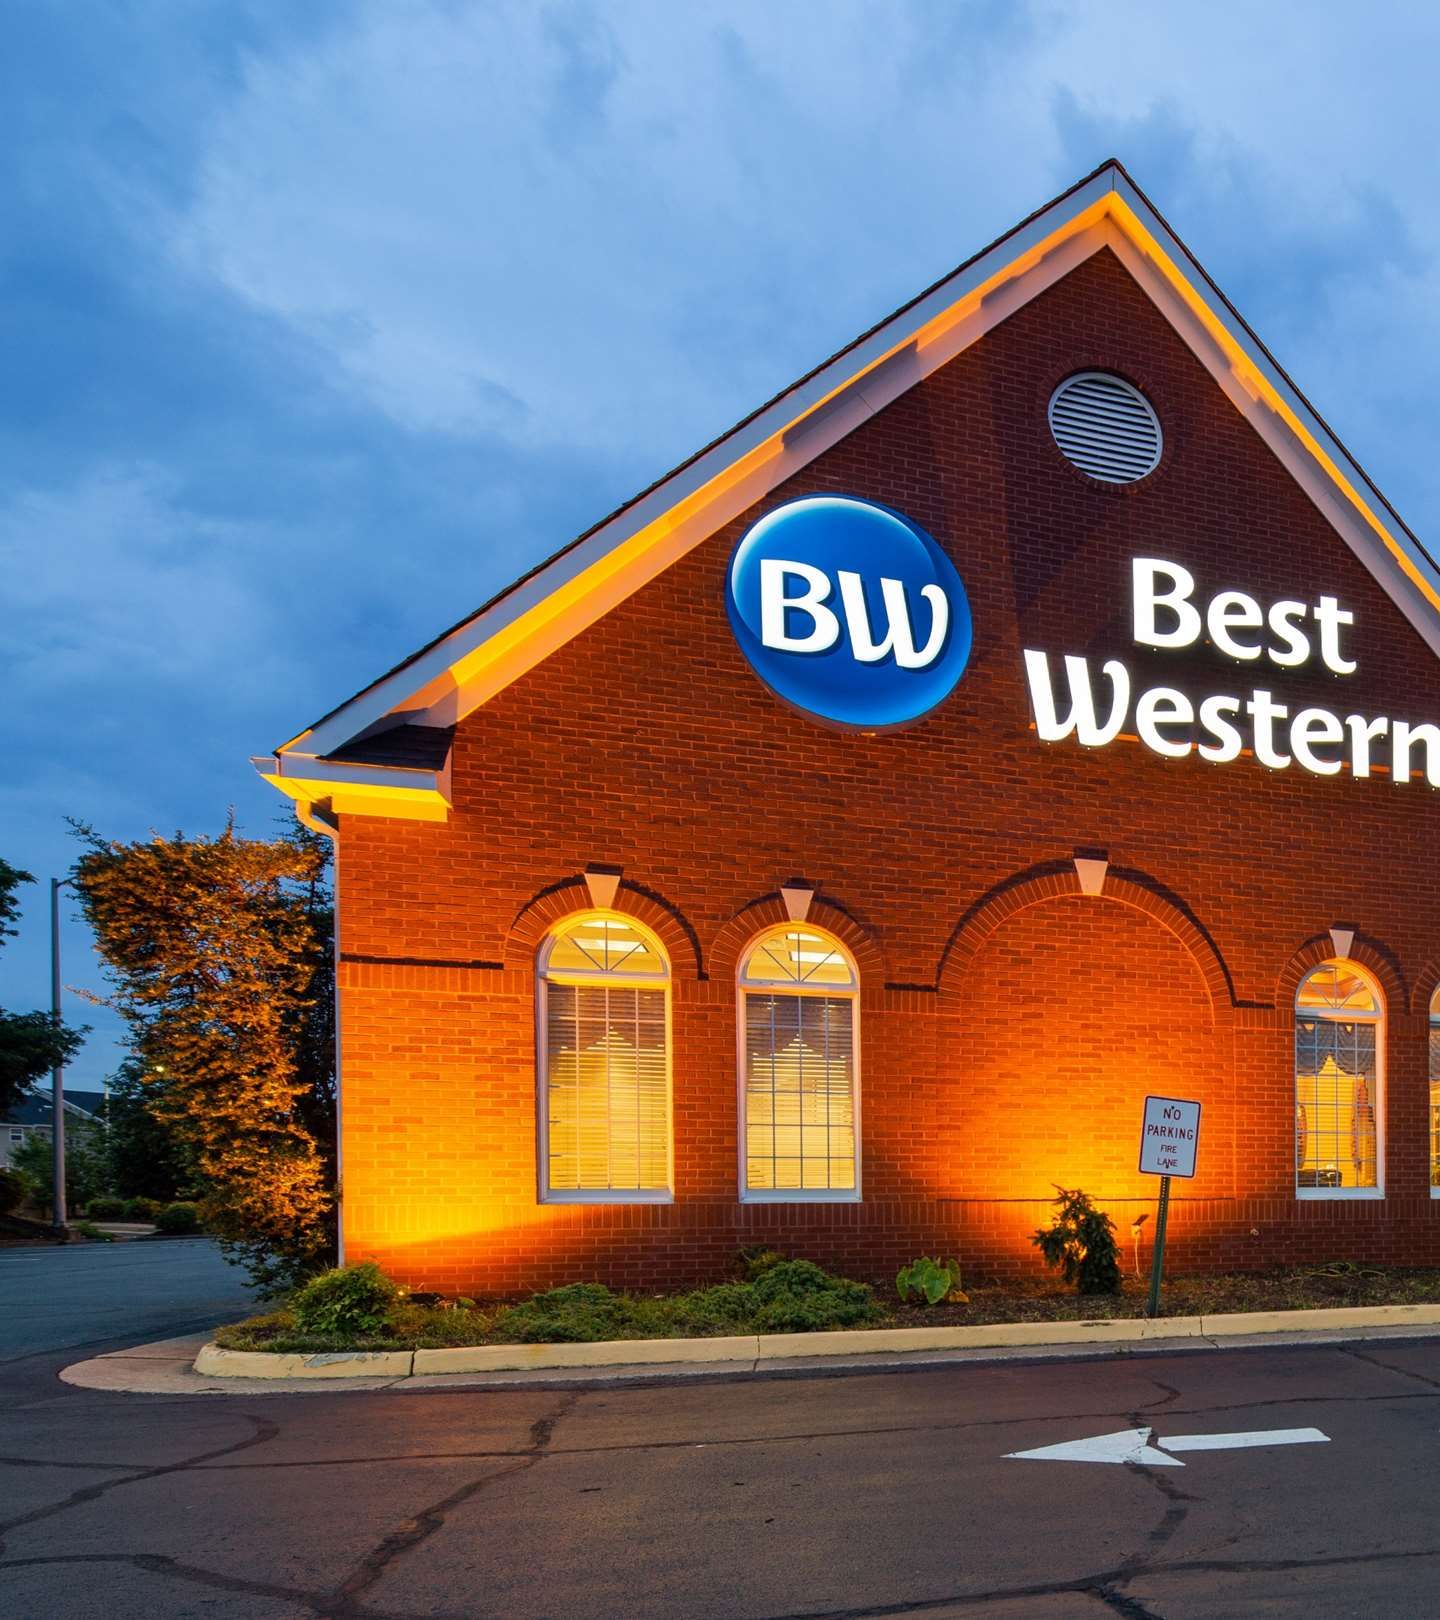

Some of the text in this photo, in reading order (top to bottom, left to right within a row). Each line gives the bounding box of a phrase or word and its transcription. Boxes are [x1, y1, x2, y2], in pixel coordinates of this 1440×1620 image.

[759, 558, 949, 669] BW
[1132, 557, 1358, 674] Best
[1163, 1108, 1182, 1121] NO
[1147, 1124, 1194, 1140] PARKING
[1160, 1144, 1177, 1154] FIRE
[1157, 1158, 1178, 1167] LANE
